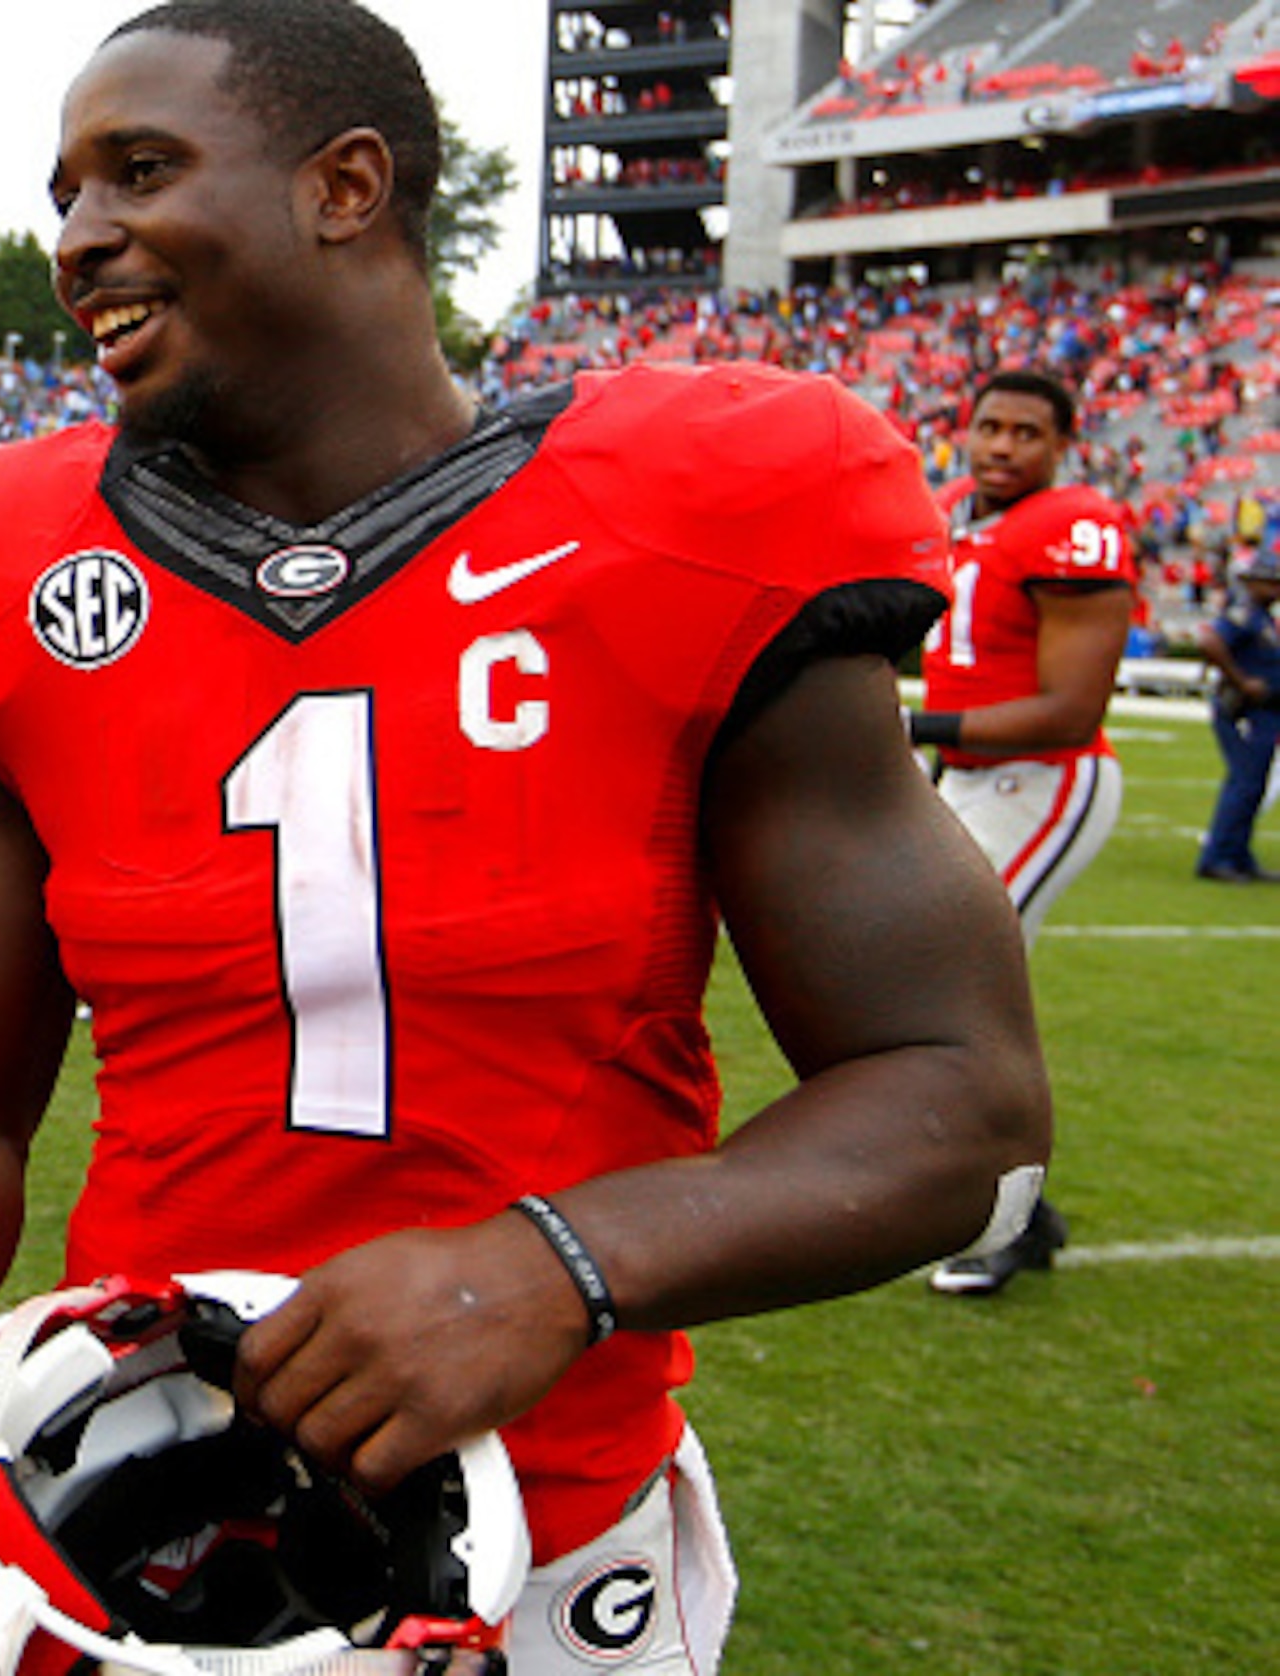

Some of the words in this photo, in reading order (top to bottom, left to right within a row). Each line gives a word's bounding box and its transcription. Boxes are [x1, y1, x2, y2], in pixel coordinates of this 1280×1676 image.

[261, 549, 345, 593] G
[1071, 519, 1119, 570] 91
[37, 556, 141, 658] SEC
[458, 627, 549, 750] C
[219, 686, 391, 1142] 1
[569, 1565, 656, 1650] G
